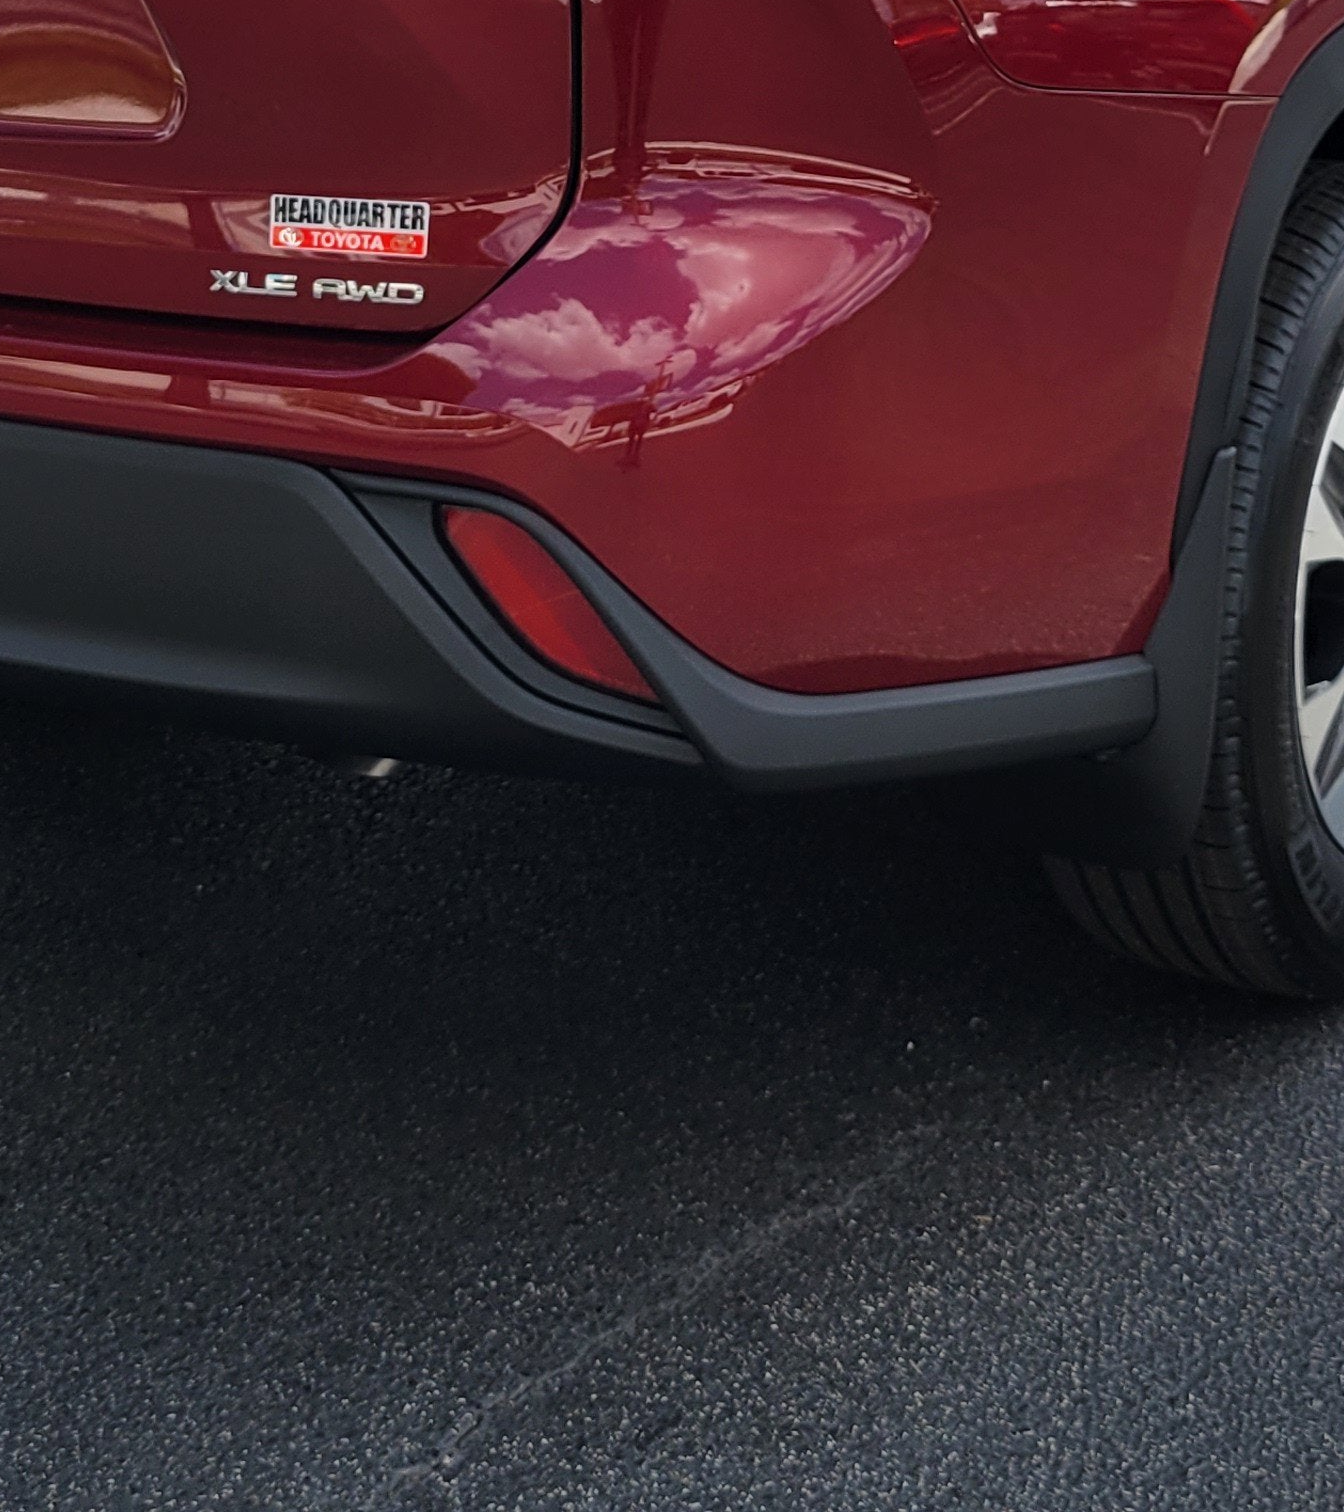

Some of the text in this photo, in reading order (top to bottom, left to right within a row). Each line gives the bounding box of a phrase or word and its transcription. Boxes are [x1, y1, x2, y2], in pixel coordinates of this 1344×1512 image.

[274, 196, 426, 231] HEADQUARTER
[311, 231, 384, 252] TOYOTA
[209, 269, 425, 306] XLE AWD
